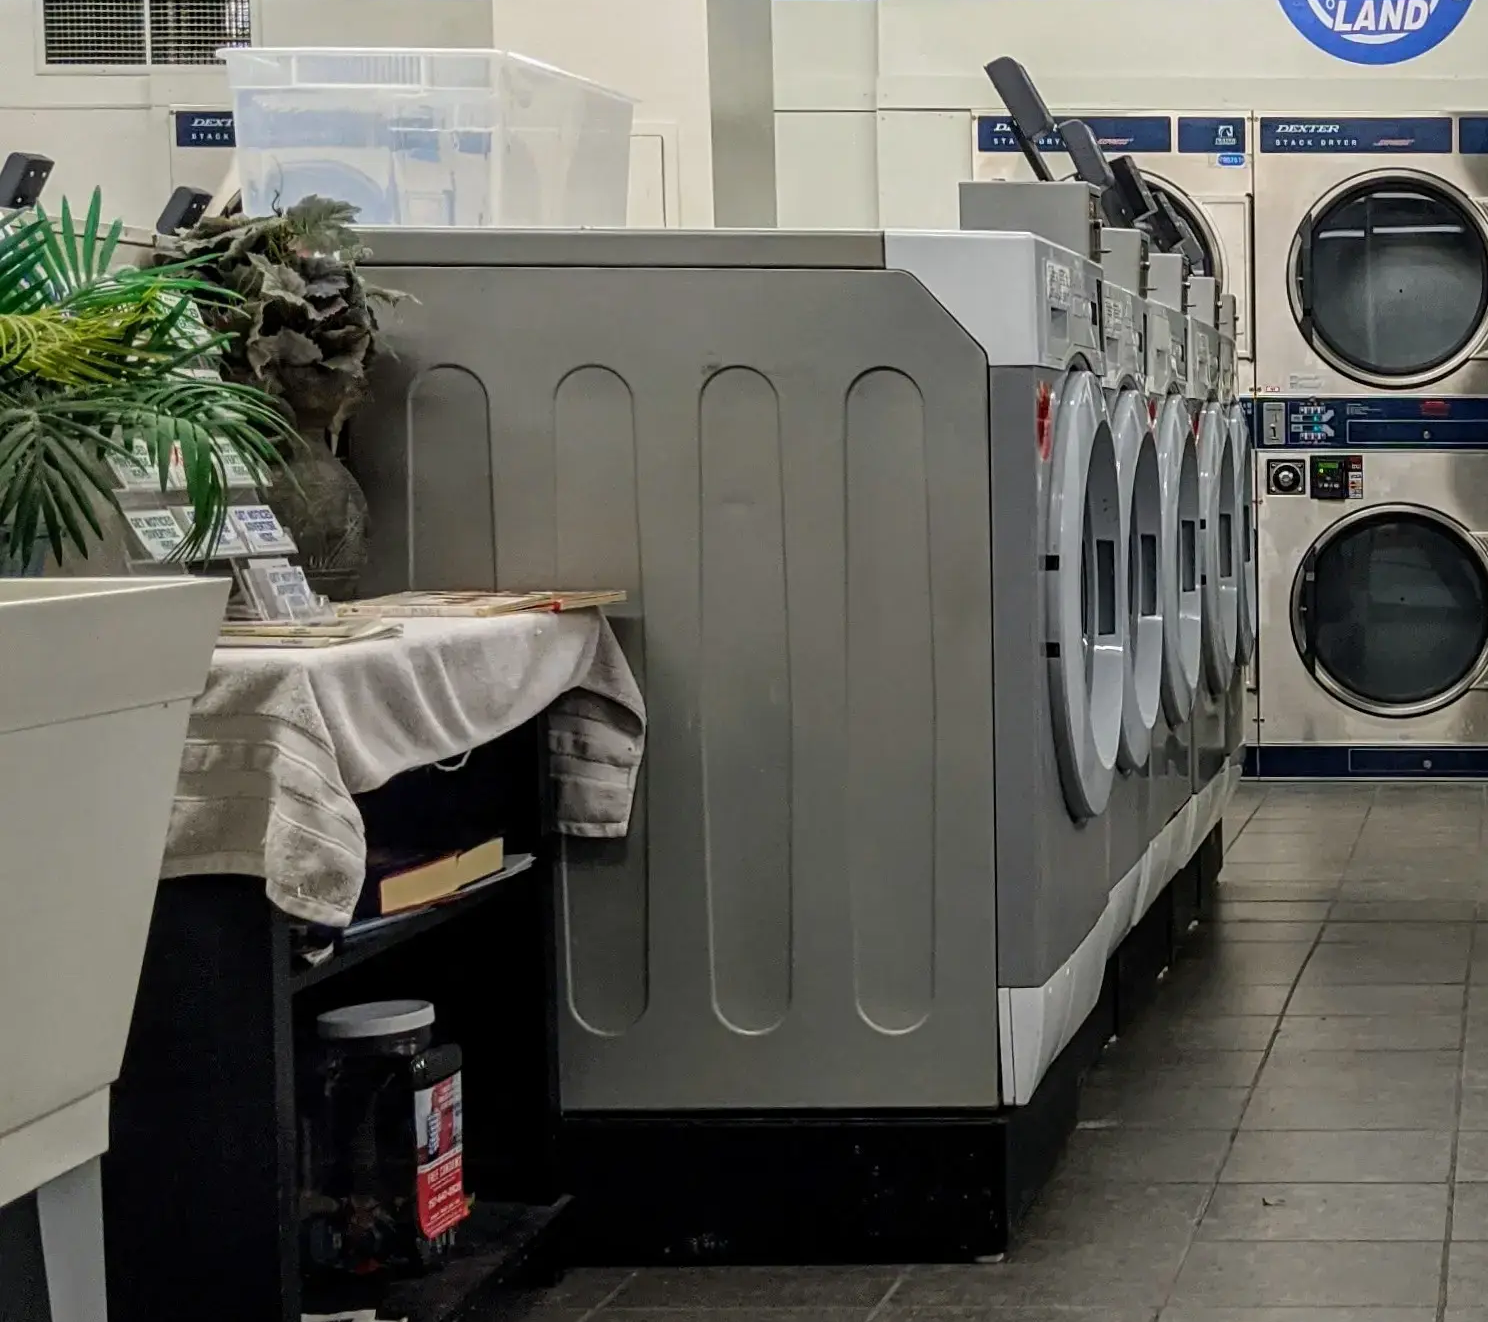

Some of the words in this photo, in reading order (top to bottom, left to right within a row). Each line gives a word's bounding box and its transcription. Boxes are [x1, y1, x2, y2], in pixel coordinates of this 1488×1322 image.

[1332, 0, 1429, 32] LAND
[190, 118, 232, 127] DEXT
[1275, 124, 1340, 133] DEXTER
[1275, 139, 1313, 147] STACK
[1320, 139, 1357, 147] DRYER
